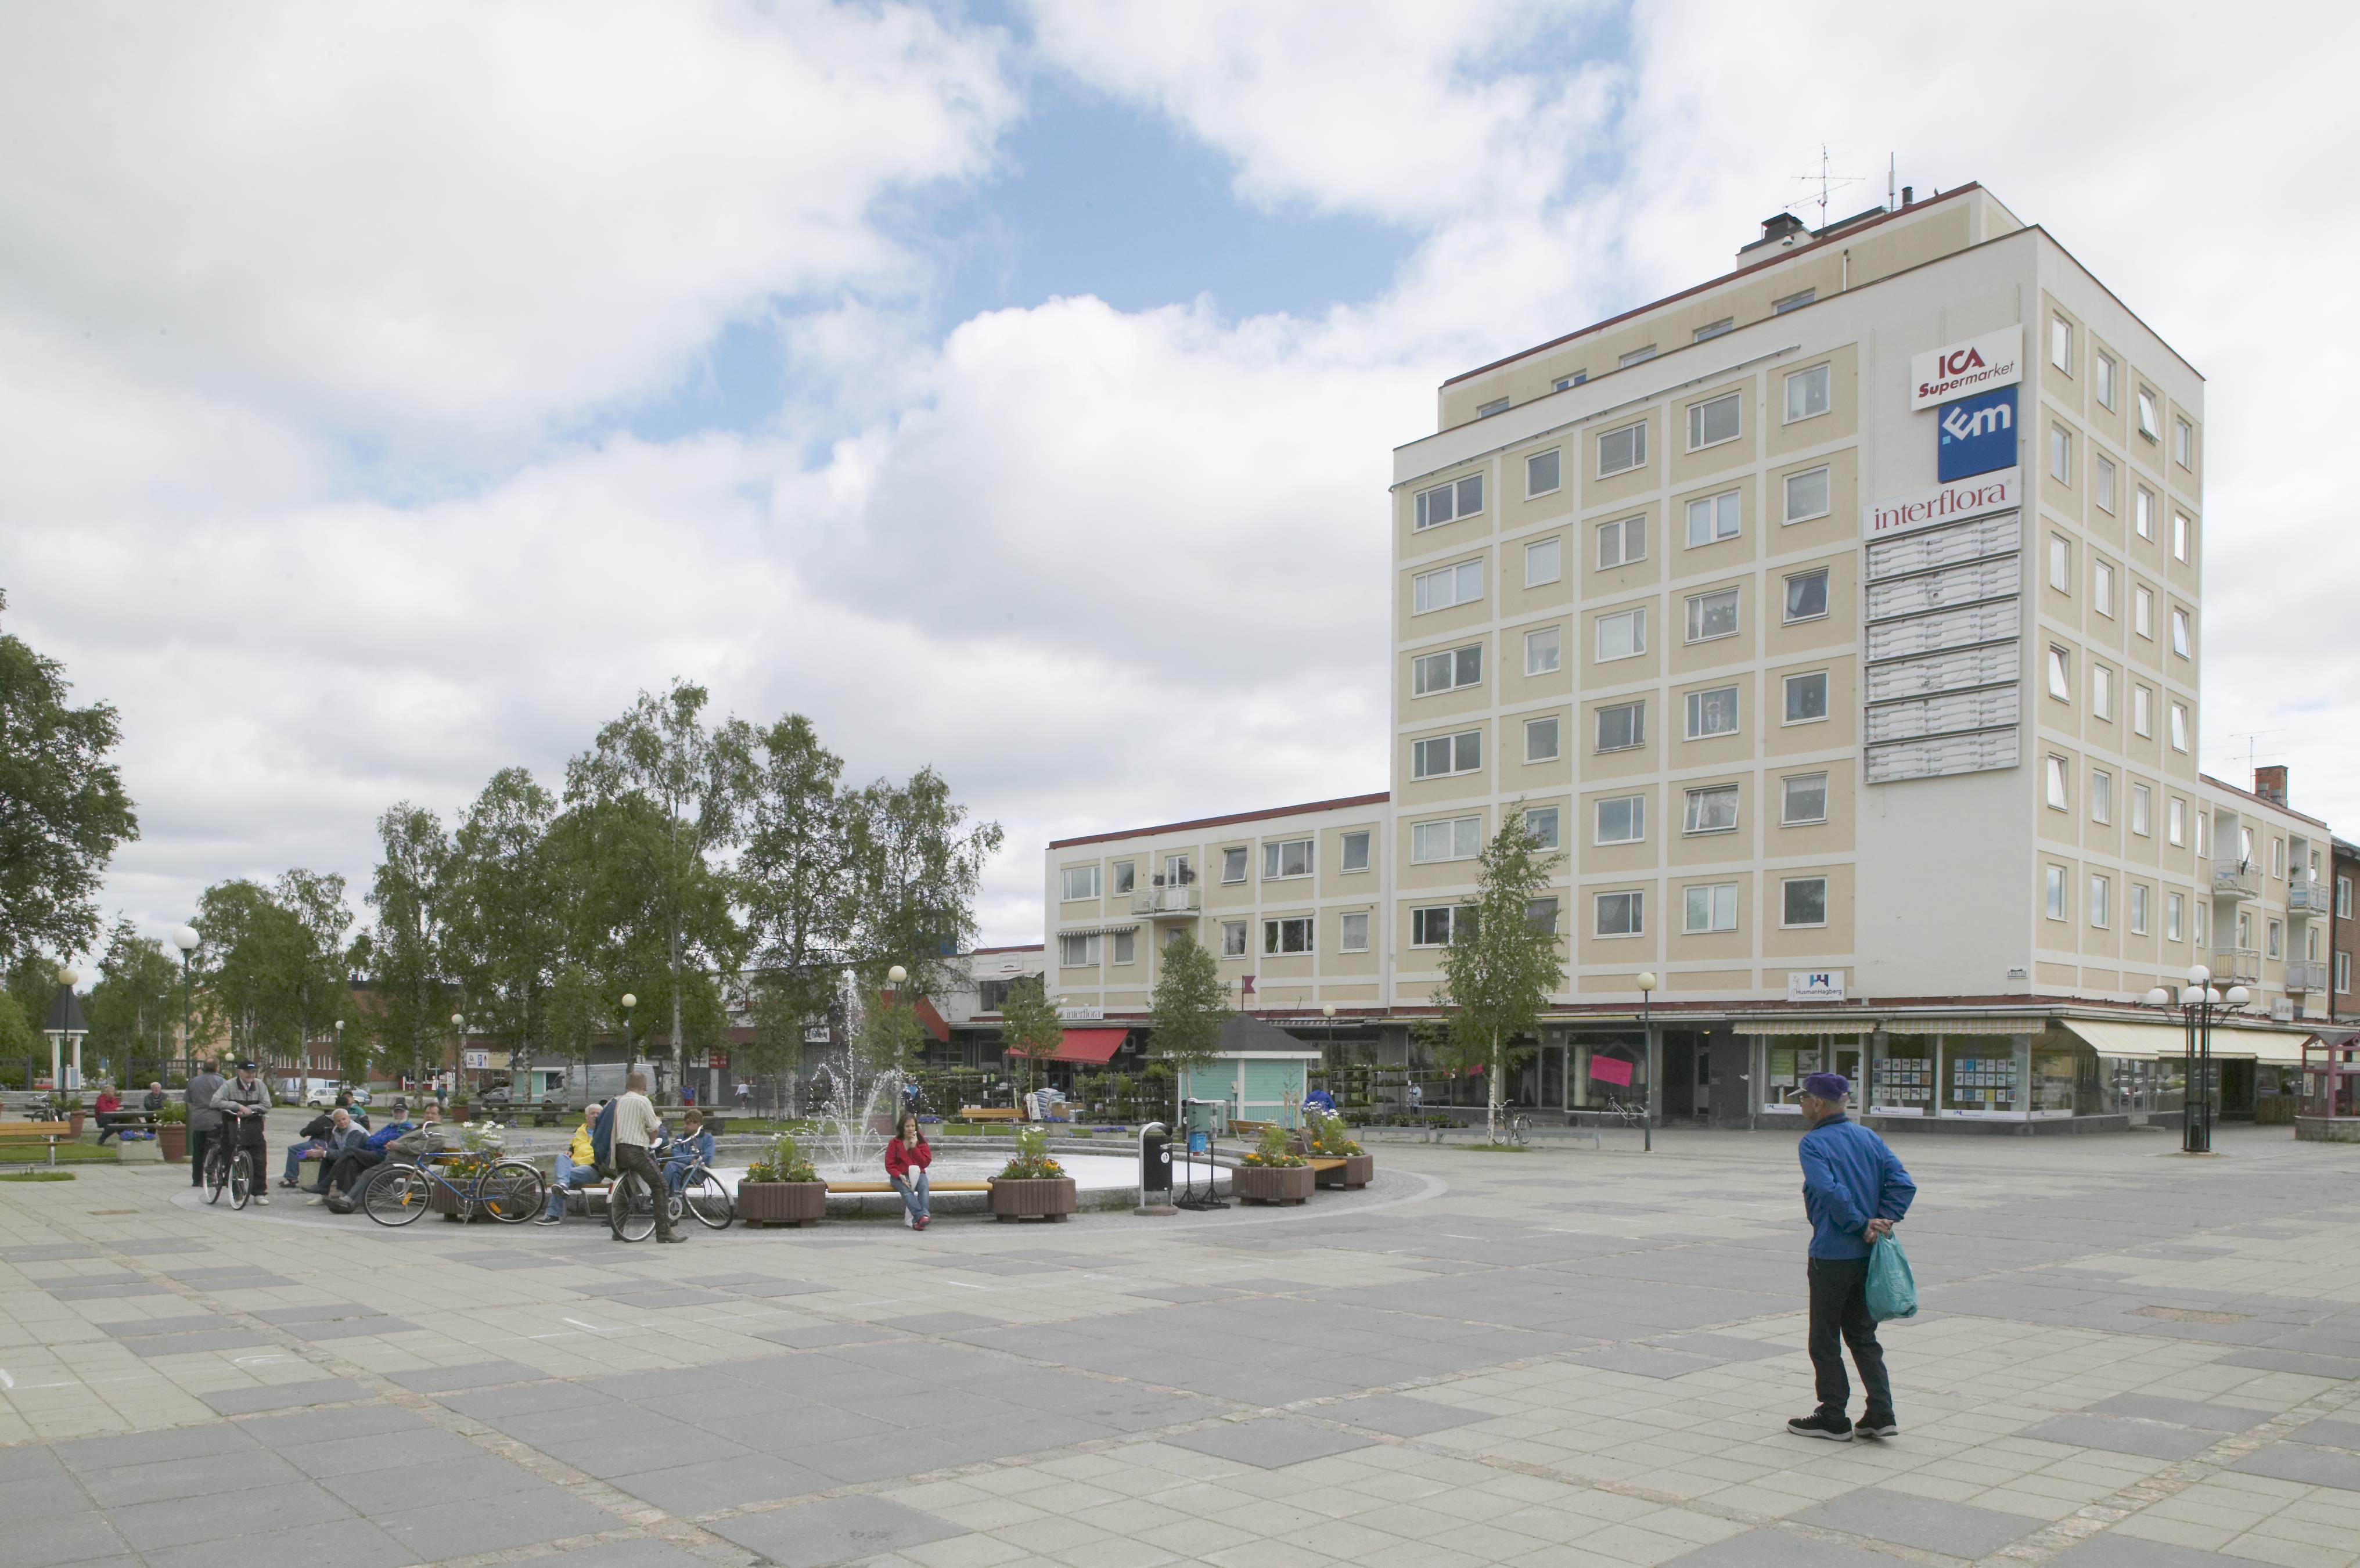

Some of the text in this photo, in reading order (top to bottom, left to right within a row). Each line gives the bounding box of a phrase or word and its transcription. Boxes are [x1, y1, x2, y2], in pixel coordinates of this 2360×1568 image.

[1918, 360, 2014, 398] Supermarket
[1938, 347, 1985, 379] ICA
[1875, 483, 2006, 531] interflora
[1066, 1008, 1100, 1019] interflora
